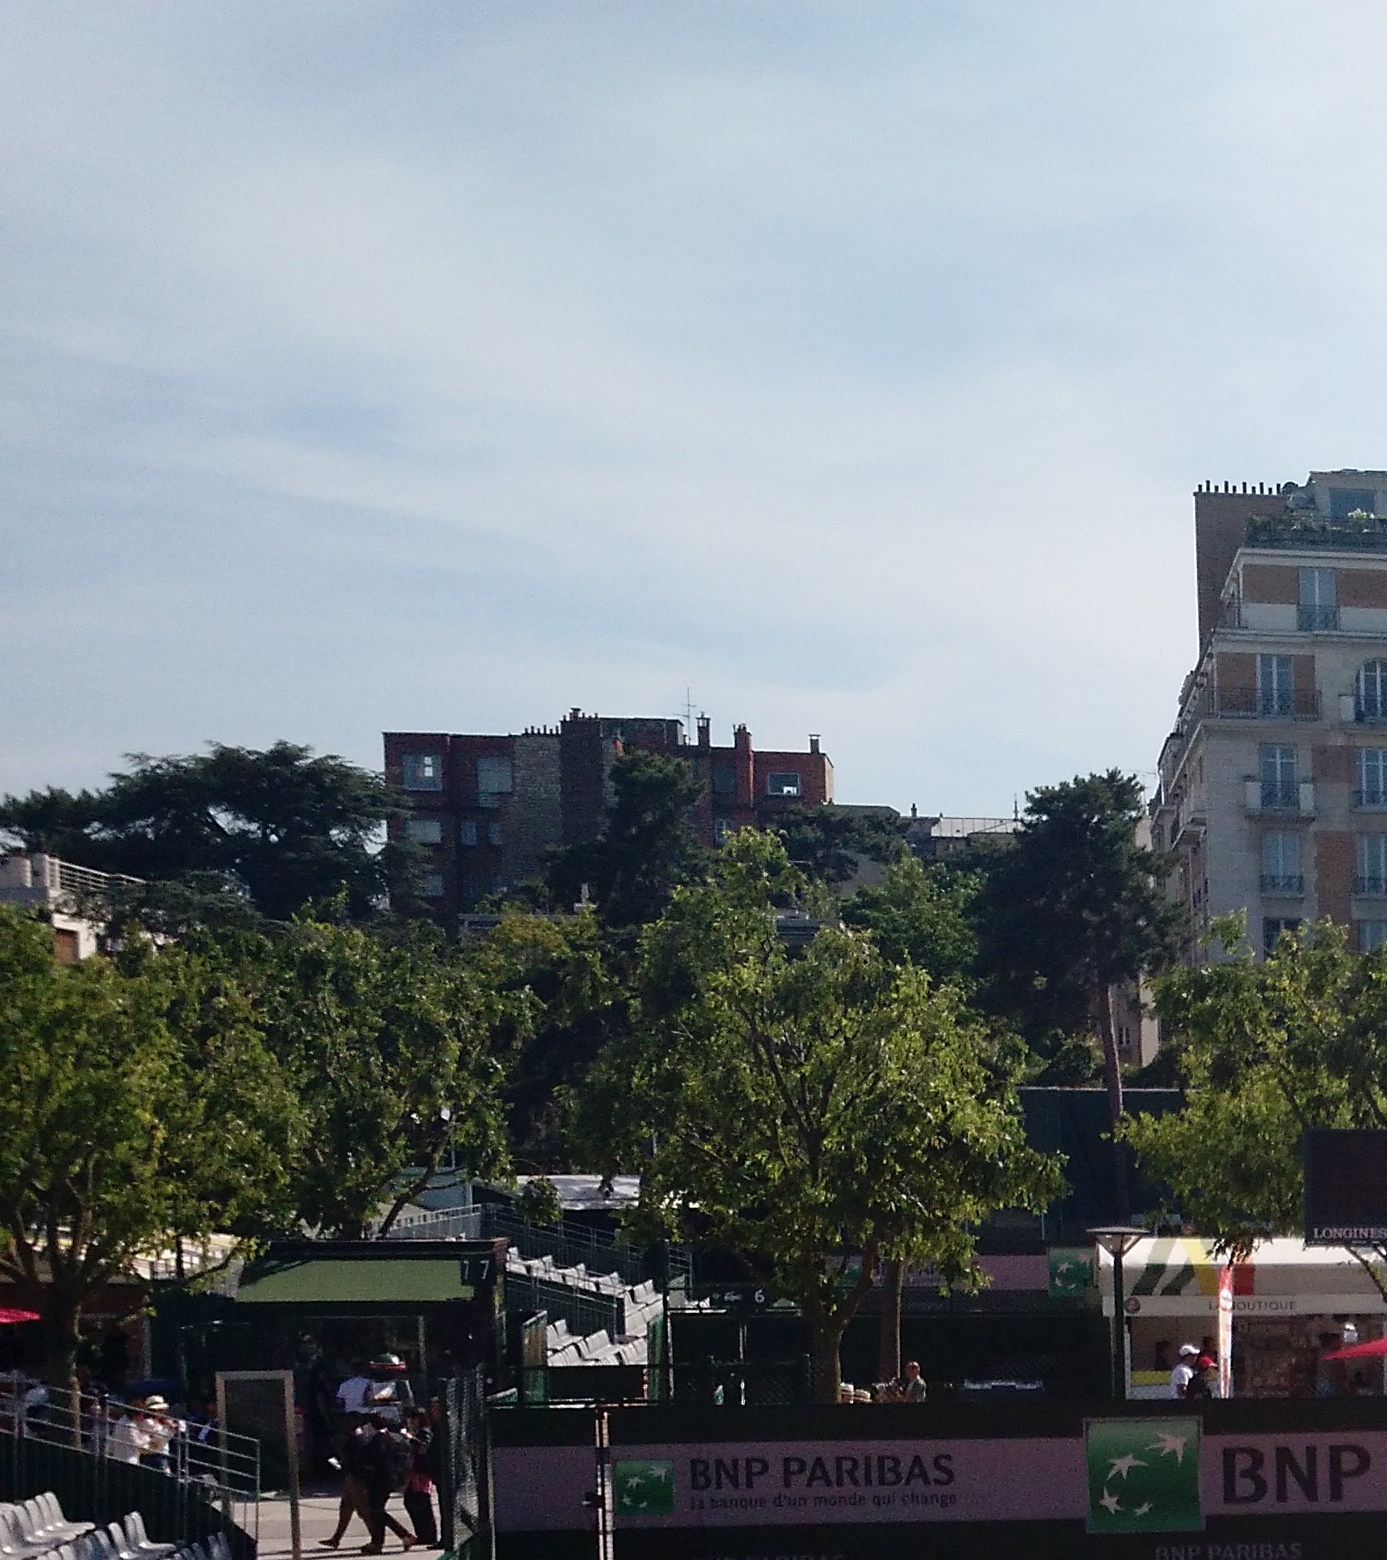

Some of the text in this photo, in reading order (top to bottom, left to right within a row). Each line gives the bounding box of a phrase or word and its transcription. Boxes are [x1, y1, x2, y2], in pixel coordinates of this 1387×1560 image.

[1313, 1227, 1387, 1239] LONGINES
[690, 1453, 955, 1491] BNP PARIBAS
[1222, 1443, 1371, 1504] BNP
[711, 1495, 766, 1511] banque
[773, 1493, 807, 1508] d'un
[813, 1492, 866, 1507] monde
[872, 1492, 896, 1508] qui
[902, 1491, 957, 1508] change
